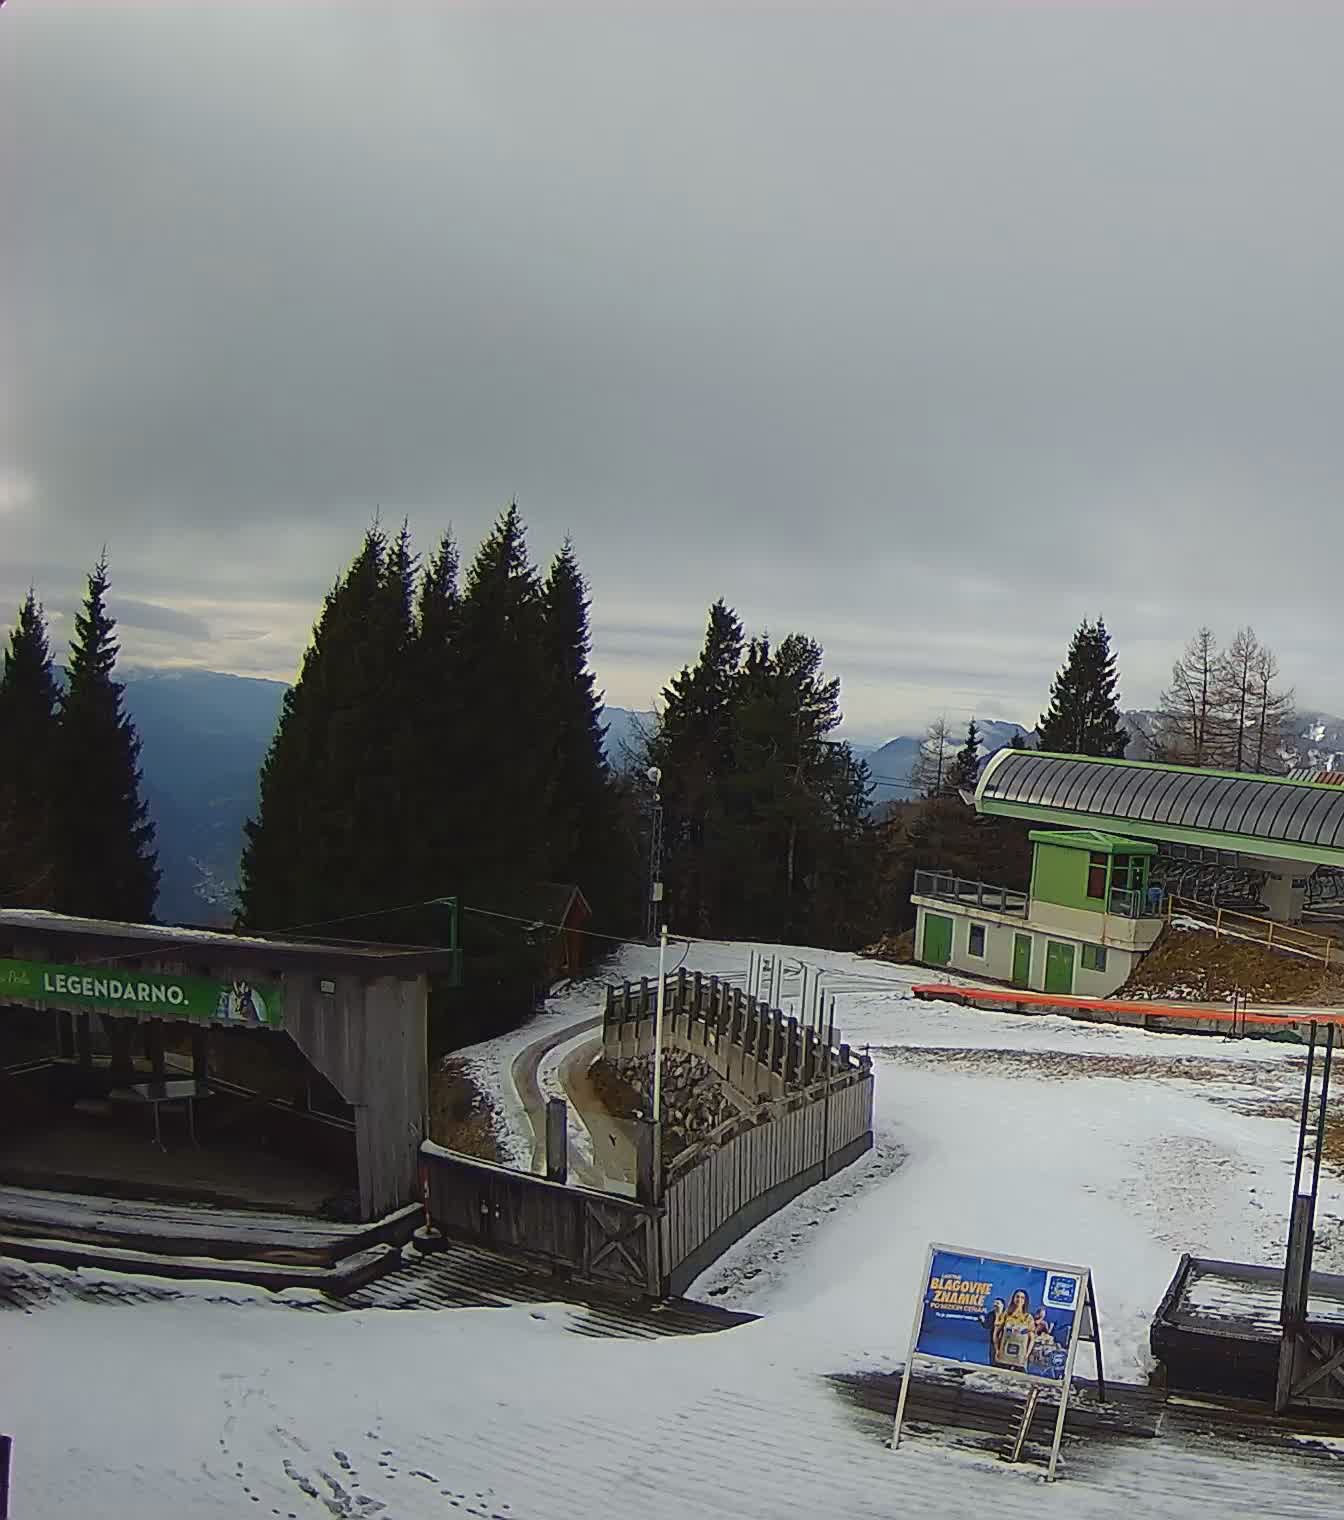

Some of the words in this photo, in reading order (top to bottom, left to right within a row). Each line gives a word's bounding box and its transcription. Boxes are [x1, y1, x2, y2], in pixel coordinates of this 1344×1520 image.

[44, 972, 189, 1005] LEGENDARNO.
[930, 1277, 992, 1295] BLAGOVNE
[932, 1290, 985, 1306] ZNAMKE
